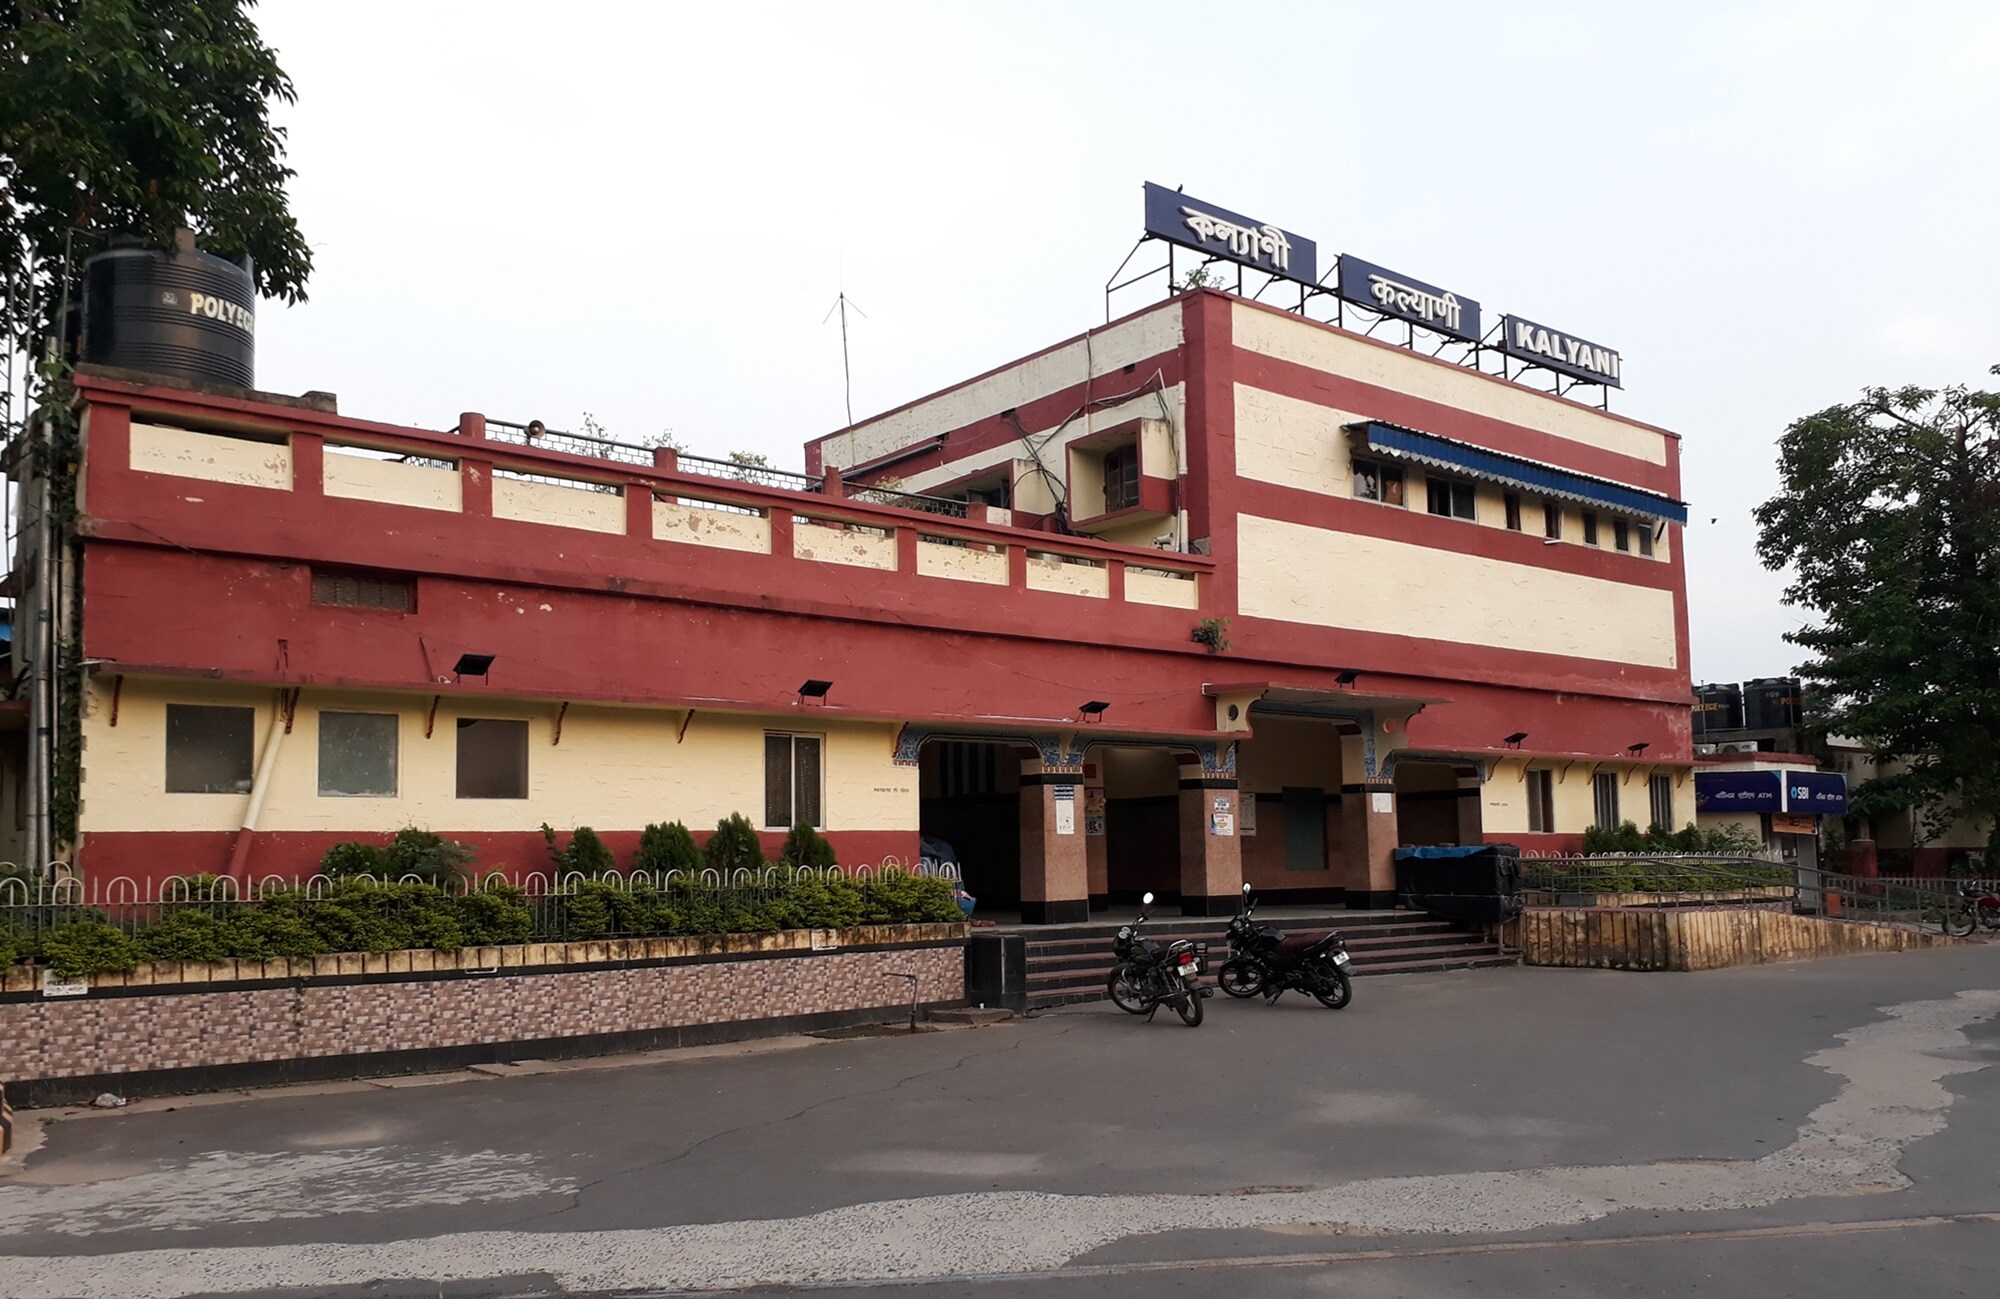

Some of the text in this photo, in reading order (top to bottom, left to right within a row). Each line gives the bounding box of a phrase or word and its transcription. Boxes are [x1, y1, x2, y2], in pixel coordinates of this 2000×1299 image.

[1181, 205, 1292, 271] কল্যাণী
[1368, 273, 1462, 330] कल्याणी
[1515, 322, 1618, 379] KALYANI
[1797, 786, 1809, 799] SBI
